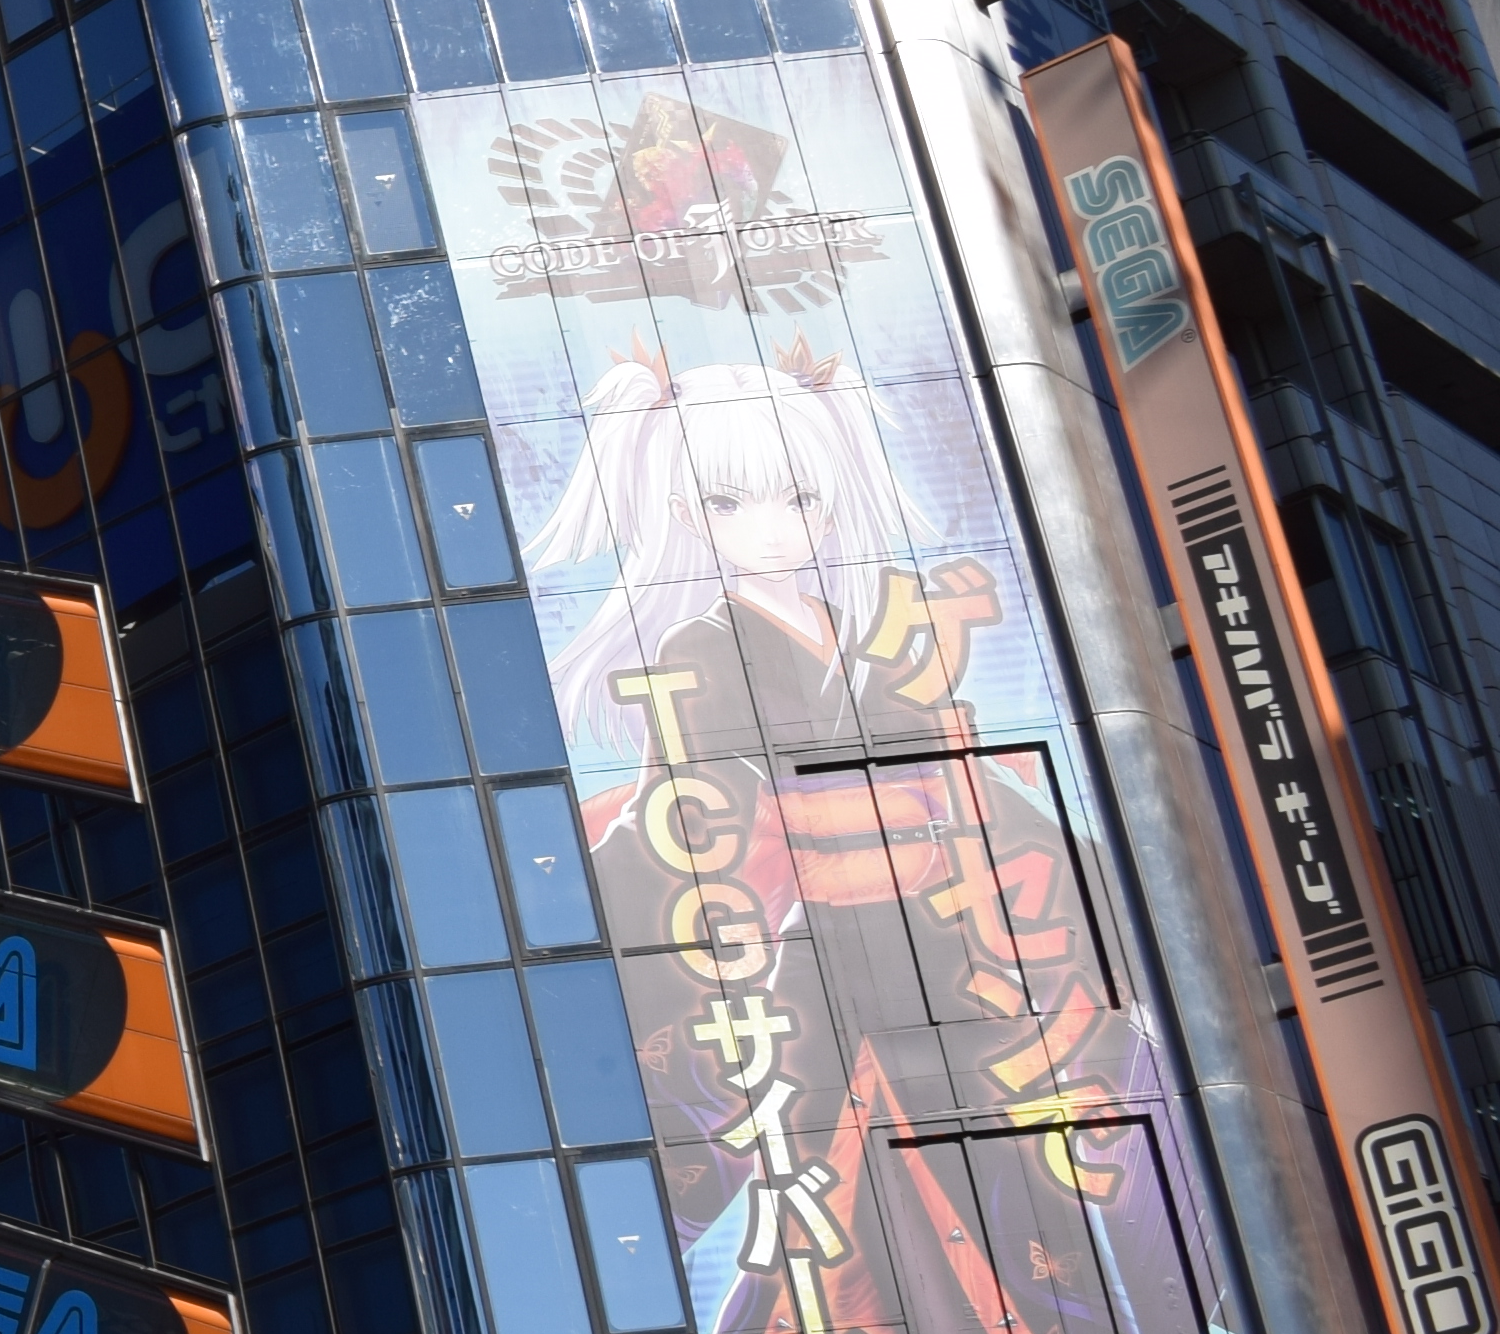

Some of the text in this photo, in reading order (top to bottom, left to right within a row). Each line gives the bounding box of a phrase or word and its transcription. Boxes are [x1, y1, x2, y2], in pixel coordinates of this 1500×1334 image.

[488, 231, 620, 285] CODE
[1064, 153, 1192, 374] SEGA
[1201, 541, 1297, 764] アキハバラ
[855, 555, 1128, 1204] ゲーセンで
